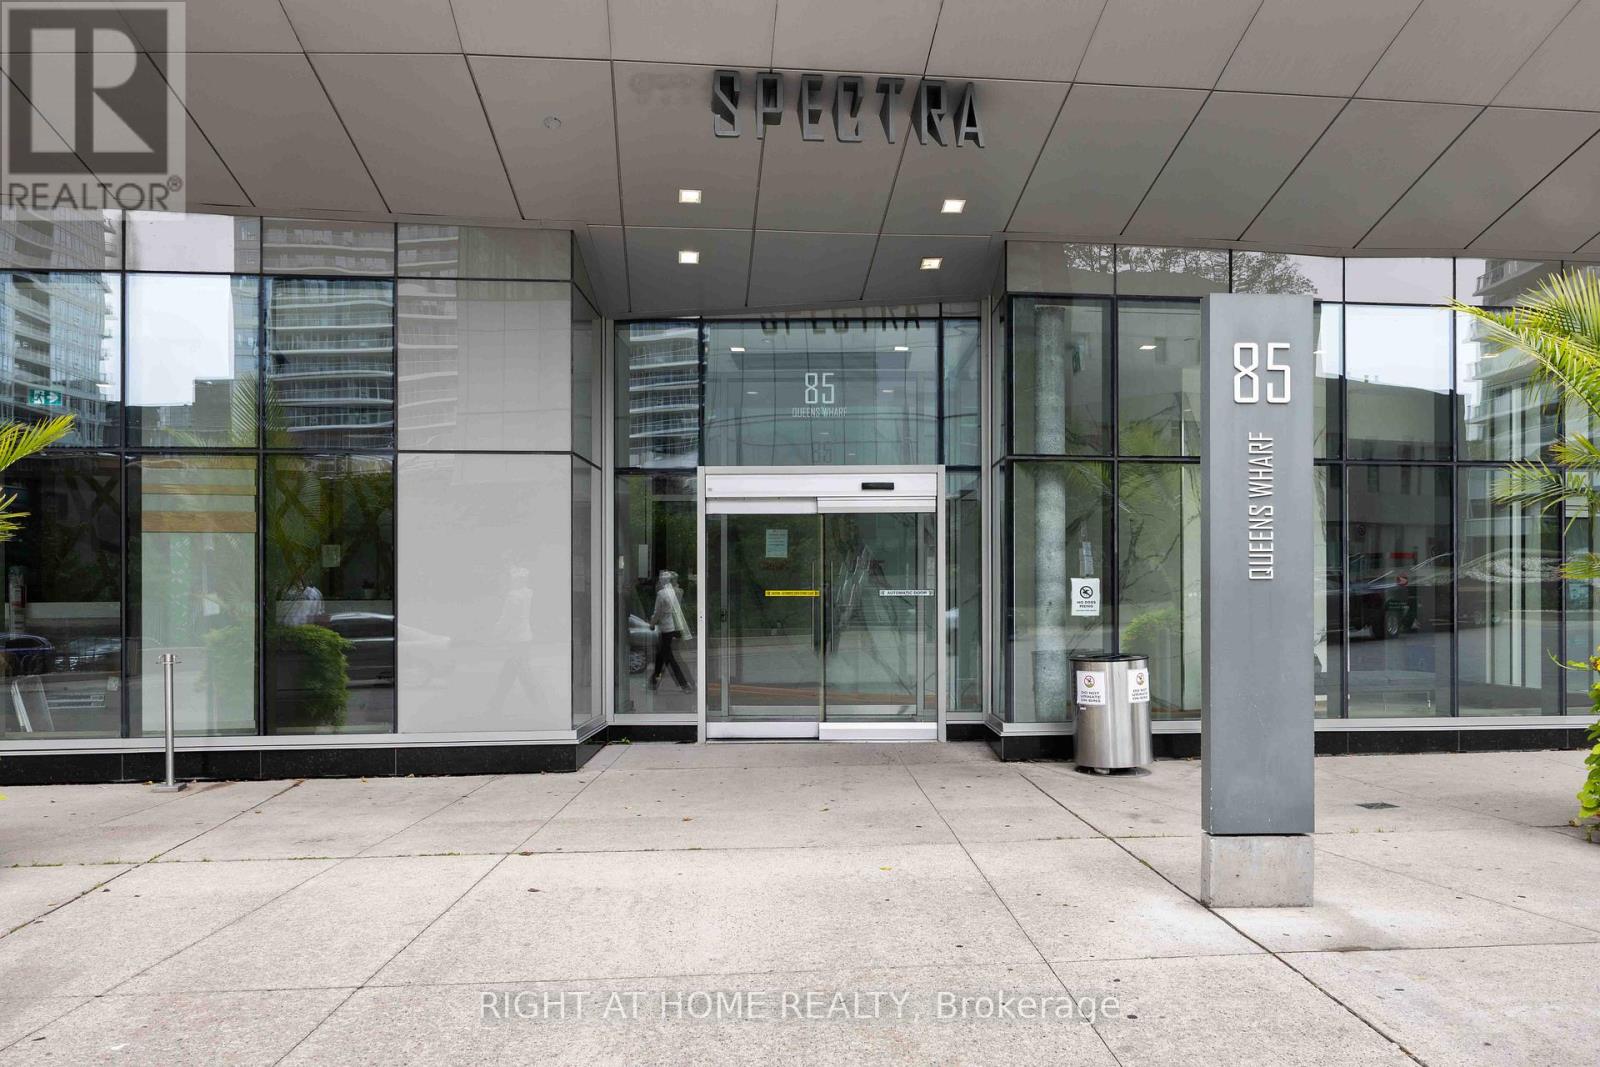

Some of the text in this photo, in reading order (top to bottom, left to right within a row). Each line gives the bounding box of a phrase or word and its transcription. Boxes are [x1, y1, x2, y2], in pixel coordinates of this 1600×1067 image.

[711, 70, 985, 148] SPECTRA
[805, 372, 835, 404] 85
[1233, 342, 1291, 404] 85
[792, 407, 847, 417] QUEENS WHARF
[1248, 432, 1274, 580] QUEENS WHARF
